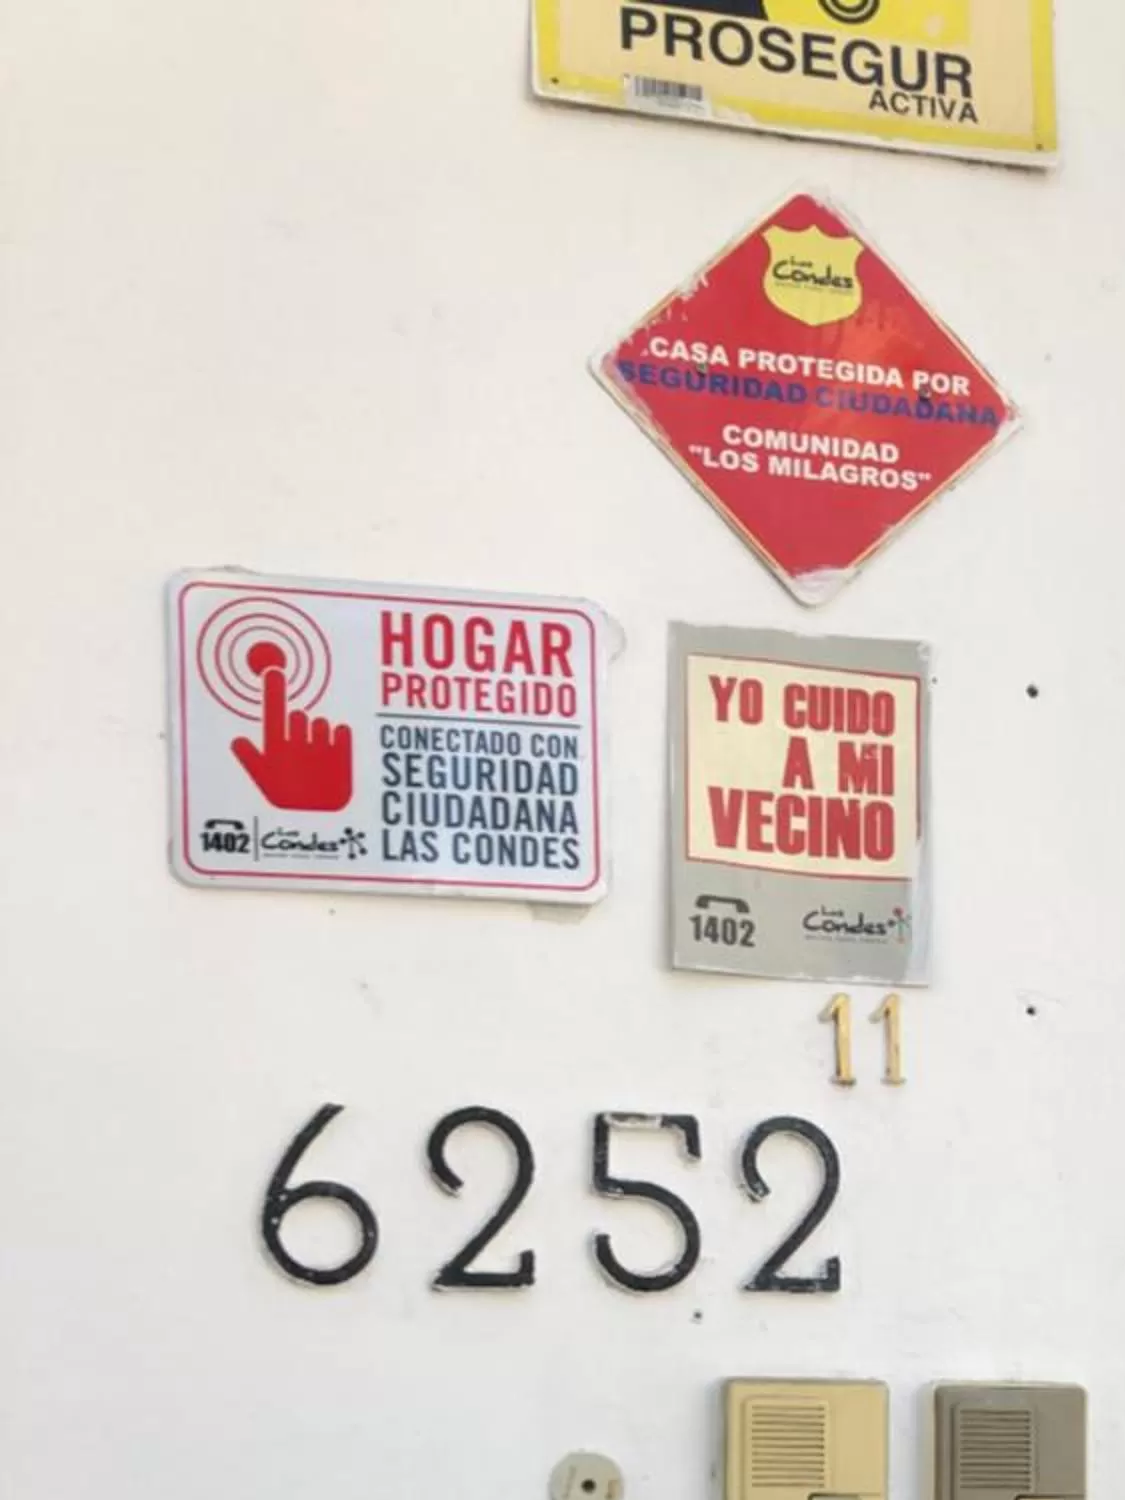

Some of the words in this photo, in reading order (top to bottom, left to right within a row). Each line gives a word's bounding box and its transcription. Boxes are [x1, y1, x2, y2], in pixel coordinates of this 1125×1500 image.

[620, 7, 972, 98] PROSEGUR
[869, 89, 979, 124] ACTIVA
[772, 259, 854, 289] Condes
[649, 336, 729, 367] CASA
[738, 347, 904, 390] PROTEGIDA
[912, 371, 970, 396] POR
[617, 359, 807, 408] SEGURIDAD
[815, 386, 998, 428] CIUDADANA
[722, 424, 899, 464] COMUNIDAD
[689, 445, 760, 473] "LOS
[769, 456, 931, 491] MILAGROS"
[380, 610, 574, 678] HOGAR
[381, 672, 577, 718] PROTEGIDO
[708, 674, 764, 725] YO
[782, 683, 895, 737] CUIDO
[379, 724, 522, 758] CONECTADO
[530, 732, 579, 759] CON
[381, 752, 579, 797] SEGURIDAD
[782, 736, 814, 790] A
[837, 741, 894, 797] MI
[381, 791, 580, 835] CIUDADANA
[708, 786, 895, 862] VECINO
[200, 831, 252, 855] 1402
[261, 831, 340, 852] Condes
[382, 829, 440, 863] LAS
[452, 834, 581, 870] CONDES
[689, 913, 756, 948] 1402
[803, 911, 888, 936] Condes
[818, 992, 906, 1087] 11
[261, 1103, 842, 1294] 6252
